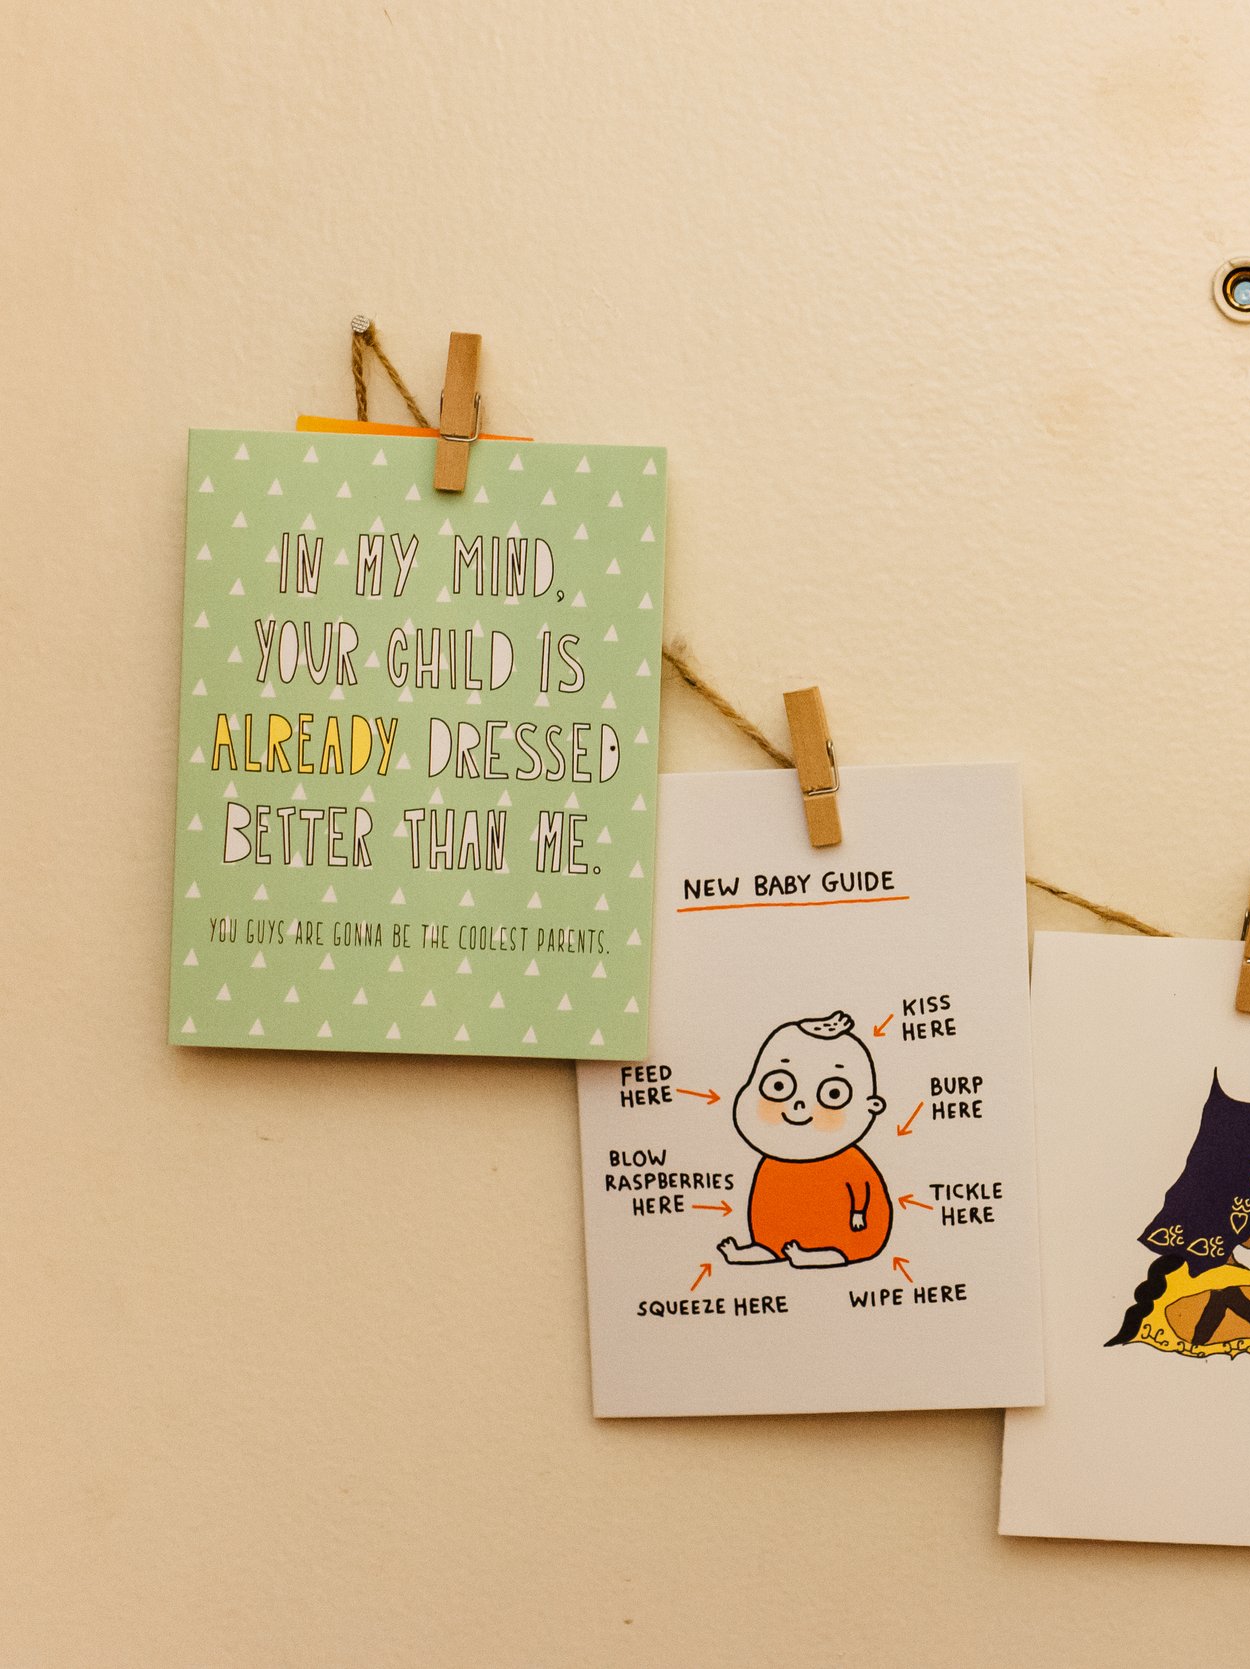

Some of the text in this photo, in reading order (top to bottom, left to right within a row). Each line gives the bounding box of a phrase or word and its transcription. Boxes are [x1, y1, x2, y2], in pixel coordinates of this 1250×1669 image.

[279, 532, 565, 603] IN MY MIND,
[254, 618, 585, 693] YOUR CHILD IS
[211, 713, 620, 783] ALREADY DRESSED
[222, 802, 601, 875] BETTER THAN ME.
[684, 871, 895, 899] NEW BABY GUIDE
[209, 917, 610, 954] YOU GUYS ARE GONNA BE THE COOLEST PARENTS.
[902, 994, 951, 1016] KISS
[902, 1018, 957, 1041] HERE
[620, 1065, 672, 1086] FEED
[930, 1076, 983, 1096] BURP
[620, 1086, 673, 1108] HERE
[932, 1100, 983, 1120] HERE
[609, 1149, 667, 1167] BLOW
[605, 1173, 735, 1191] RASPBERRIES
[929, 1182, 1003, 1200] TICKLE
[633, 1195, 685, 1216] HERE
[941, 1206, 995, 1226] HERE
[636, 1296, 789, 1317] SQUEEZE HERE
[849, 1284, 967, 1308] WIPE HERE
